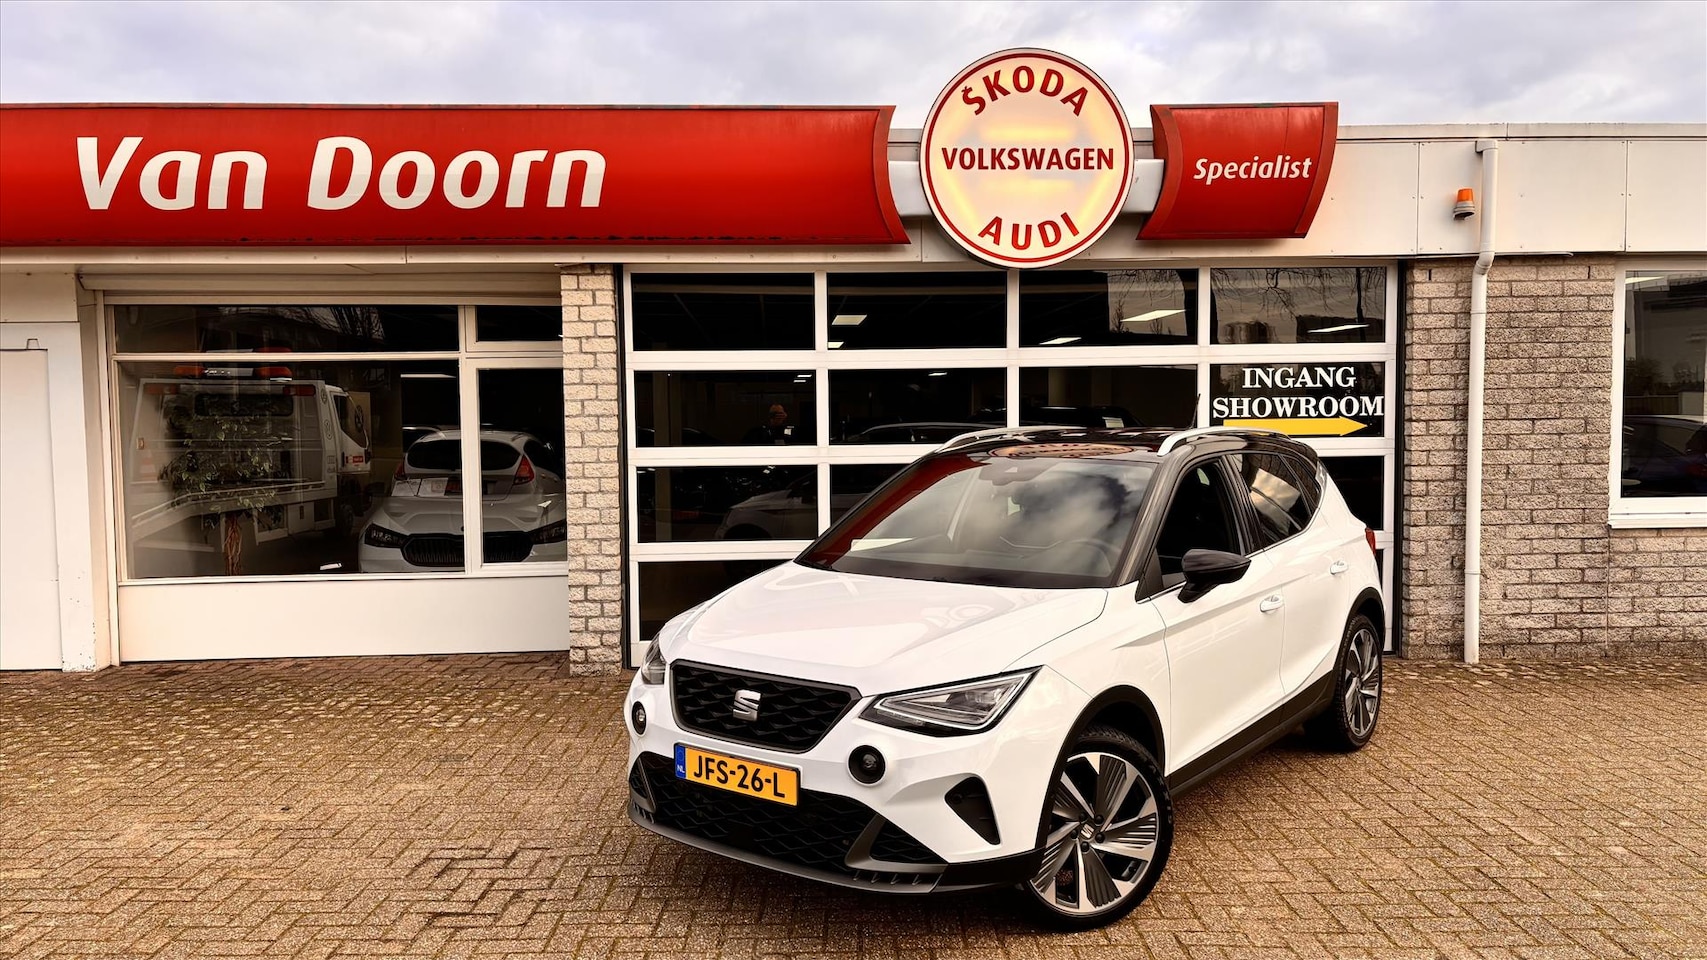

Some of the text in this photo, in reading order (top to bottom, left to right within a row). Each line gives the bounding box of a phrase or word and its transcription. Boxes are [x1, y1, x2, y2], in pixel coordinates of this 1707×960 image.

[961, 65, 1088, 117] ŠKODA
[76, 135, 607, 211] Van Doorn
[941, 147, 1114, 171] VOLKSWAGEN
[1193, 154, 1312, 185] Specialist
[977, 211, 1080, 251] AUDI
[1242, 366, 1357, 389] INGANG
[1212, 395, 1385, 419] SHOWROOM
[693, 755, 786, 799] JFS-26-L
